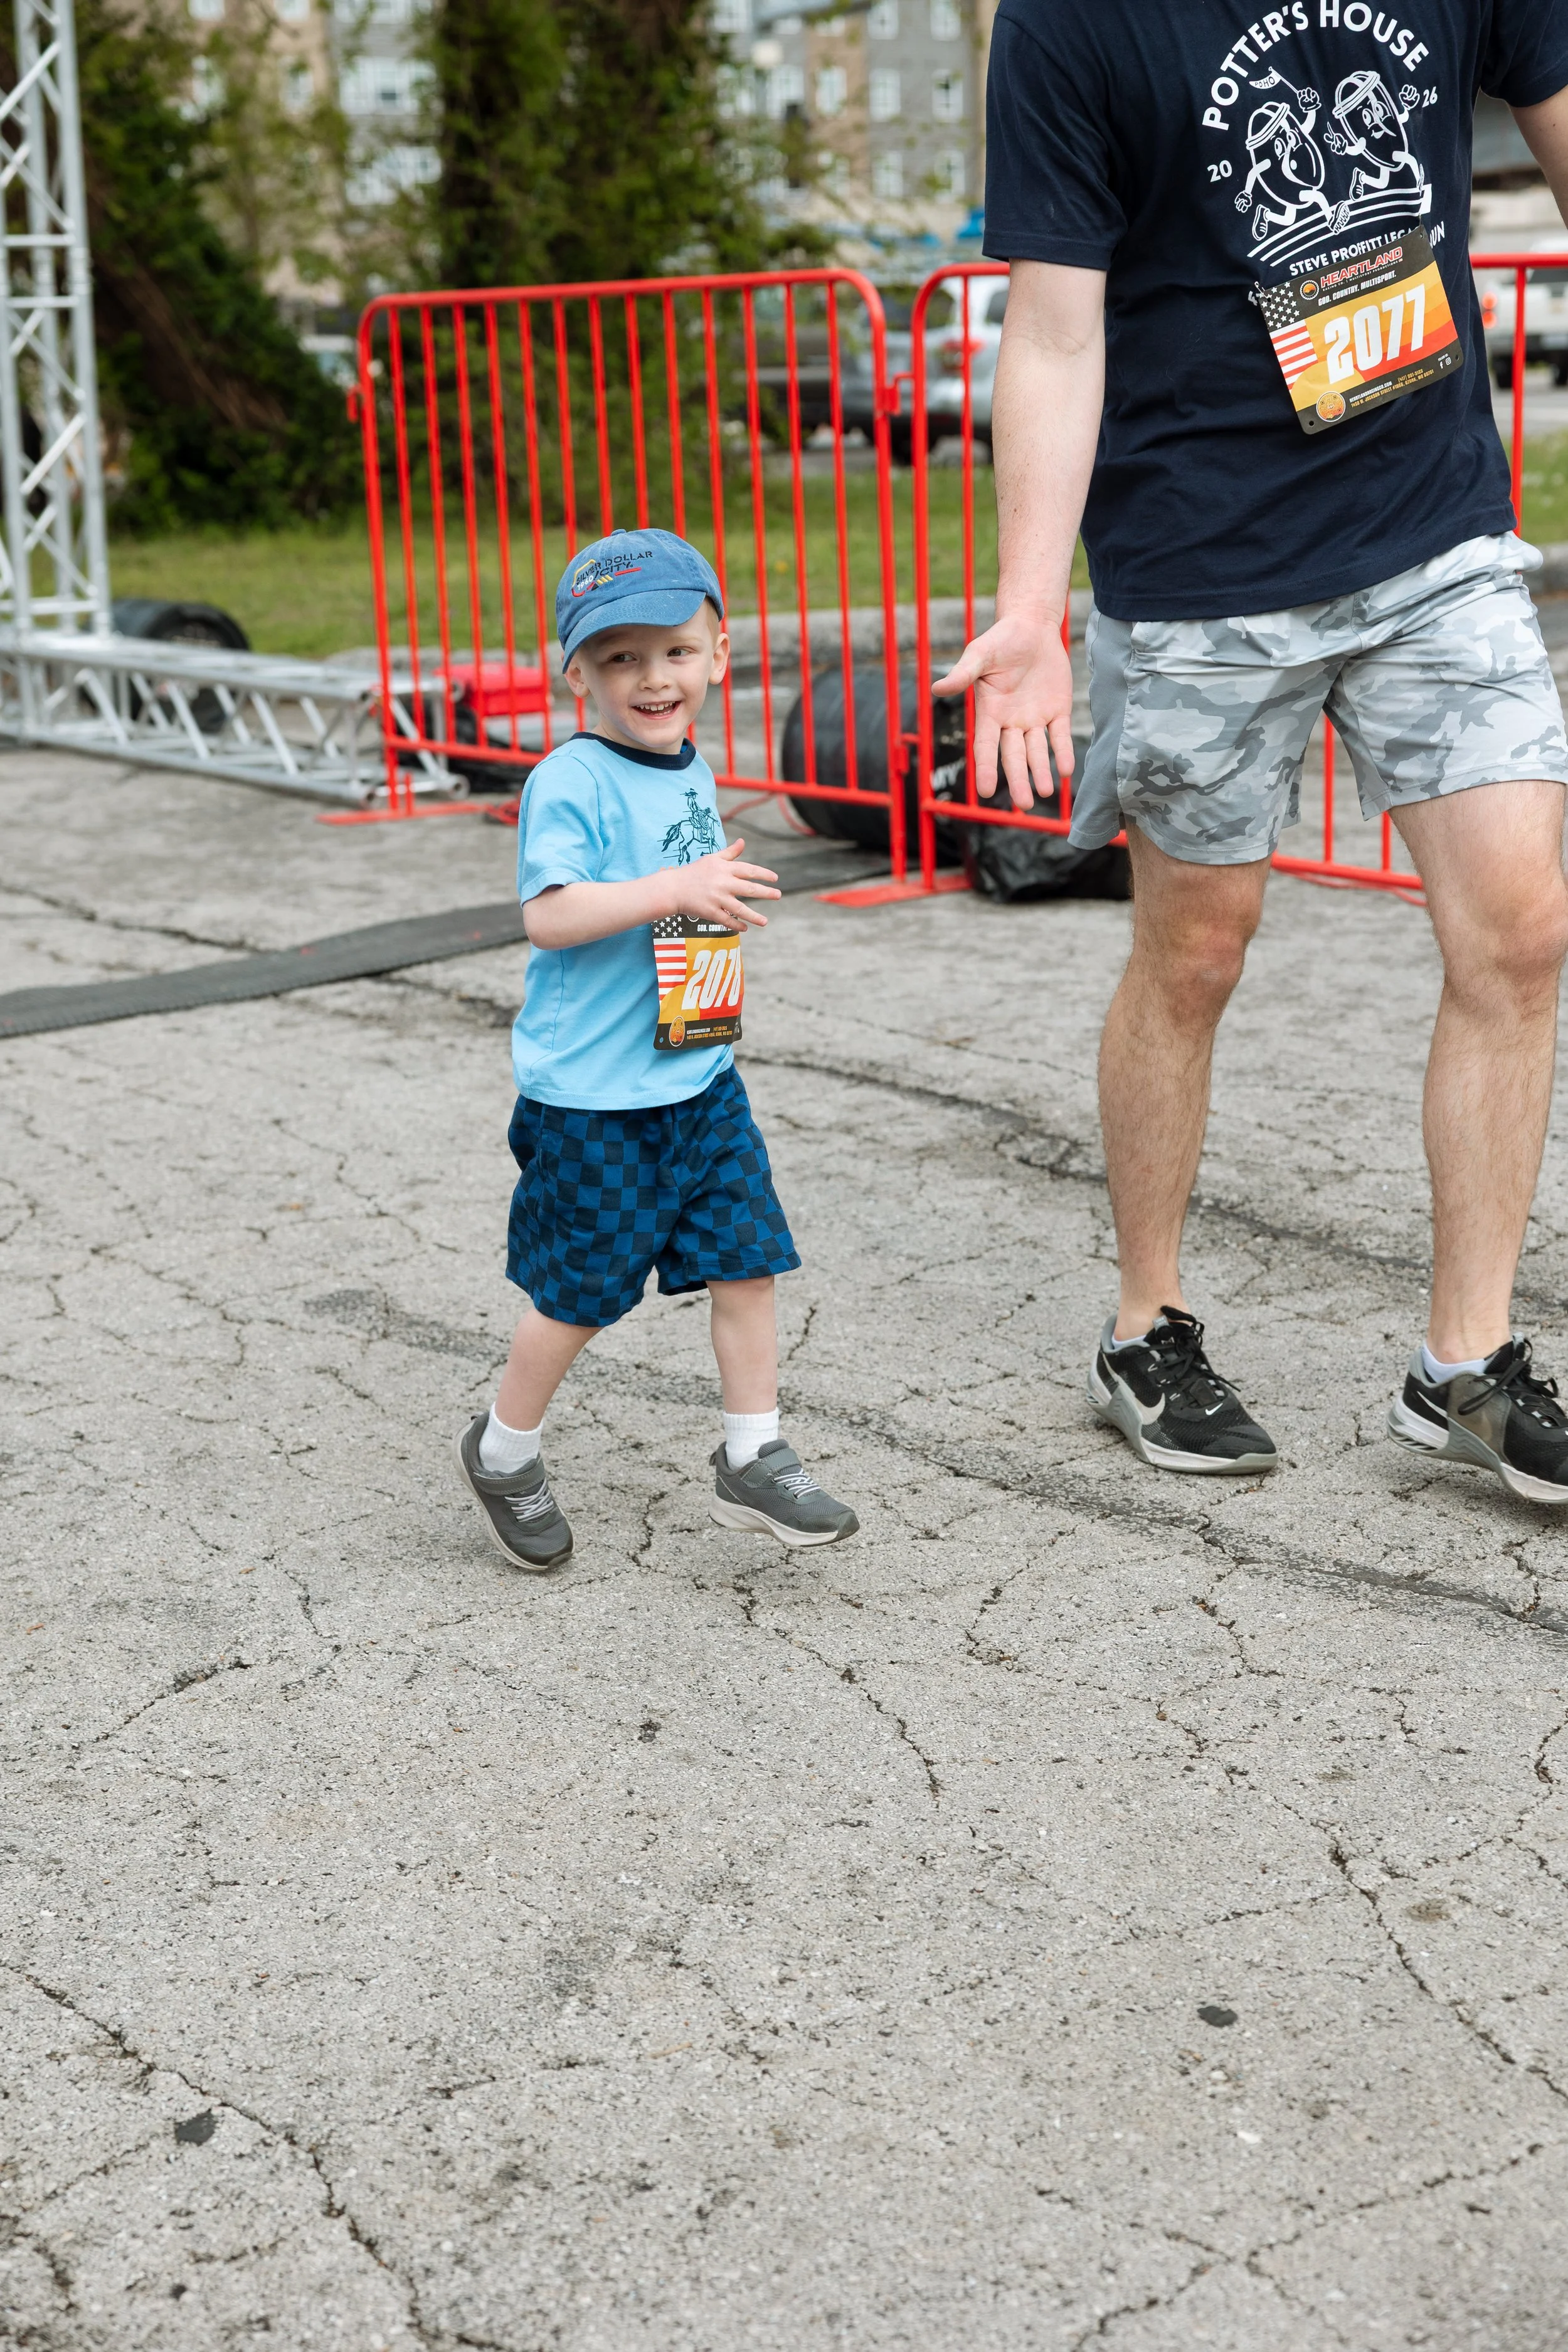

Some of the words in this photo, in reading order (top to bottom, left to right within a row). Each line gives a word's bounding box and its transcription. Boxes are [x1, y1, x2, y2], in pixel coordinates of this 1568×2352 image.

[1202, 1, 1309, 130] POTTER'S
[1320, 0, 1429, 72] HOUSE
[1255, 77, 1275, 88] POHO
[1422, 86, 1438, 108] 26
[1207, 160, 1232, 182] 20
[1289, 253, 1329, 276] STEVE
[1331, 236, 1382, 263] PROFFITT
[1384, 227, 1412, 245] LEG
[1320, 246, 1402, 289] HEARTLAND
[1318, 295, 1332, 307] GOD.
[1332, 284, 1360, 300] COUNTRY.
[1360, 270, 1396, 290] MULTISPORT.
[1349, 272, 1372, 282] MULTISPORT
[1372, 260, 1398, 273] PRODUCTIONS
[1324, 283, 1426, 384] 2077
[576, 562, 601, 585] SILVER
[605, 551, 653, 567] DOLLAR
[577, 575, 594, 590] 1960
[681, 945, 742, 1010] 2078
